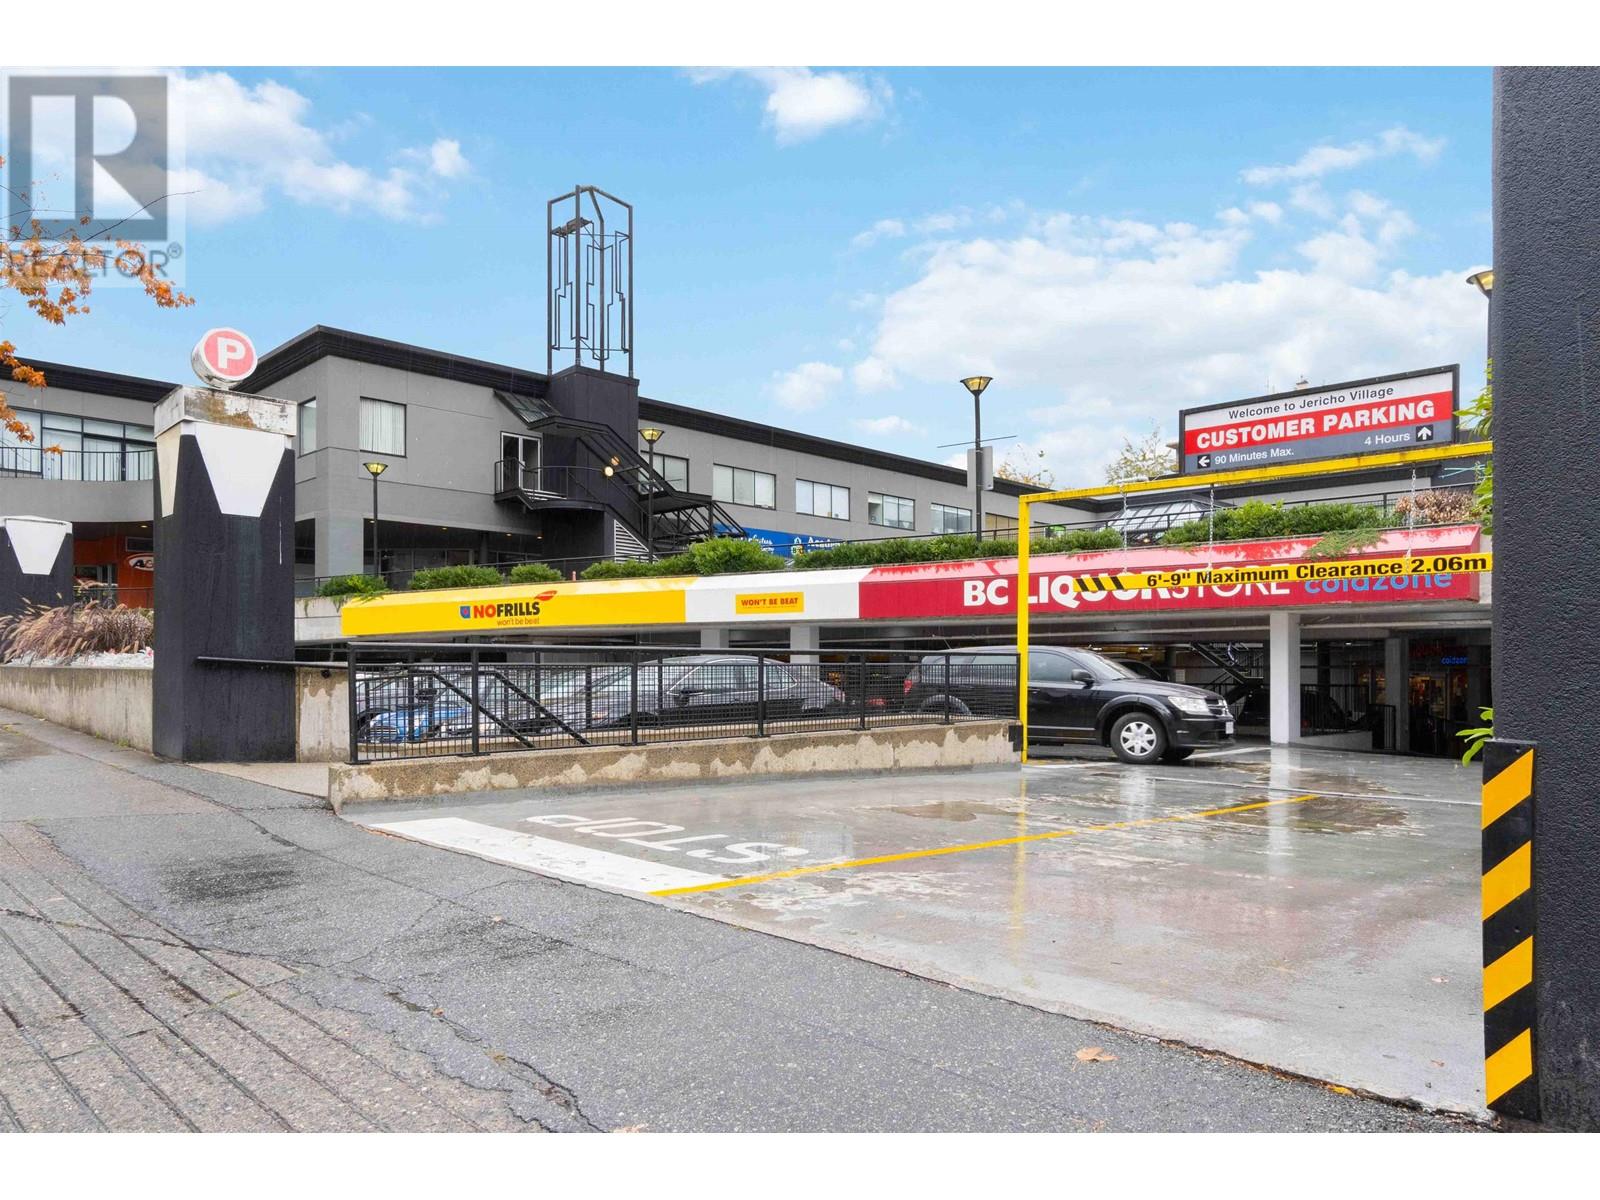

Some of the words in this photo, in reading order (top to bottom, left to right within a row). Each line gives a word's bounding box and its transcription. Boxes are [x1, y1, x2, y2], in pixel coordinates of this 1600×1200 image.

[216, 336, 246, 369] P
[1228, 404, 1281, 420] Welcome
[1284, 402, 1296, 411] to
[1299, 394, 1346, 409] Jericho
[1349, 386, 1394, 401] Village
[1196, 417, 1315, 449] CUSTOMER
[1322, 399, 1435, 432] PARKING
[1364, 436, 1372, 446] 4
[1375, 432, 1411, 445] Hours
[1214, 455, 1227, 465] 90
[1229, 450, 1268, 463] Minutes
[1270, 447, 1295, 458] Max.
[1196, 568, 1289, 585] Maximum
[1296, 561, 1403, 579] Clearance
[1411, 556, 1487, 573] 2.06m
[741, 598, 767, 606] WON'T
[780, 597, 798, 605] BEAT
[963, 578, 1009, 607] BC
[515, 617, 523, 625] be
[525, 616, 540, 625] beat
[525, 814, 809, 864] STOP
